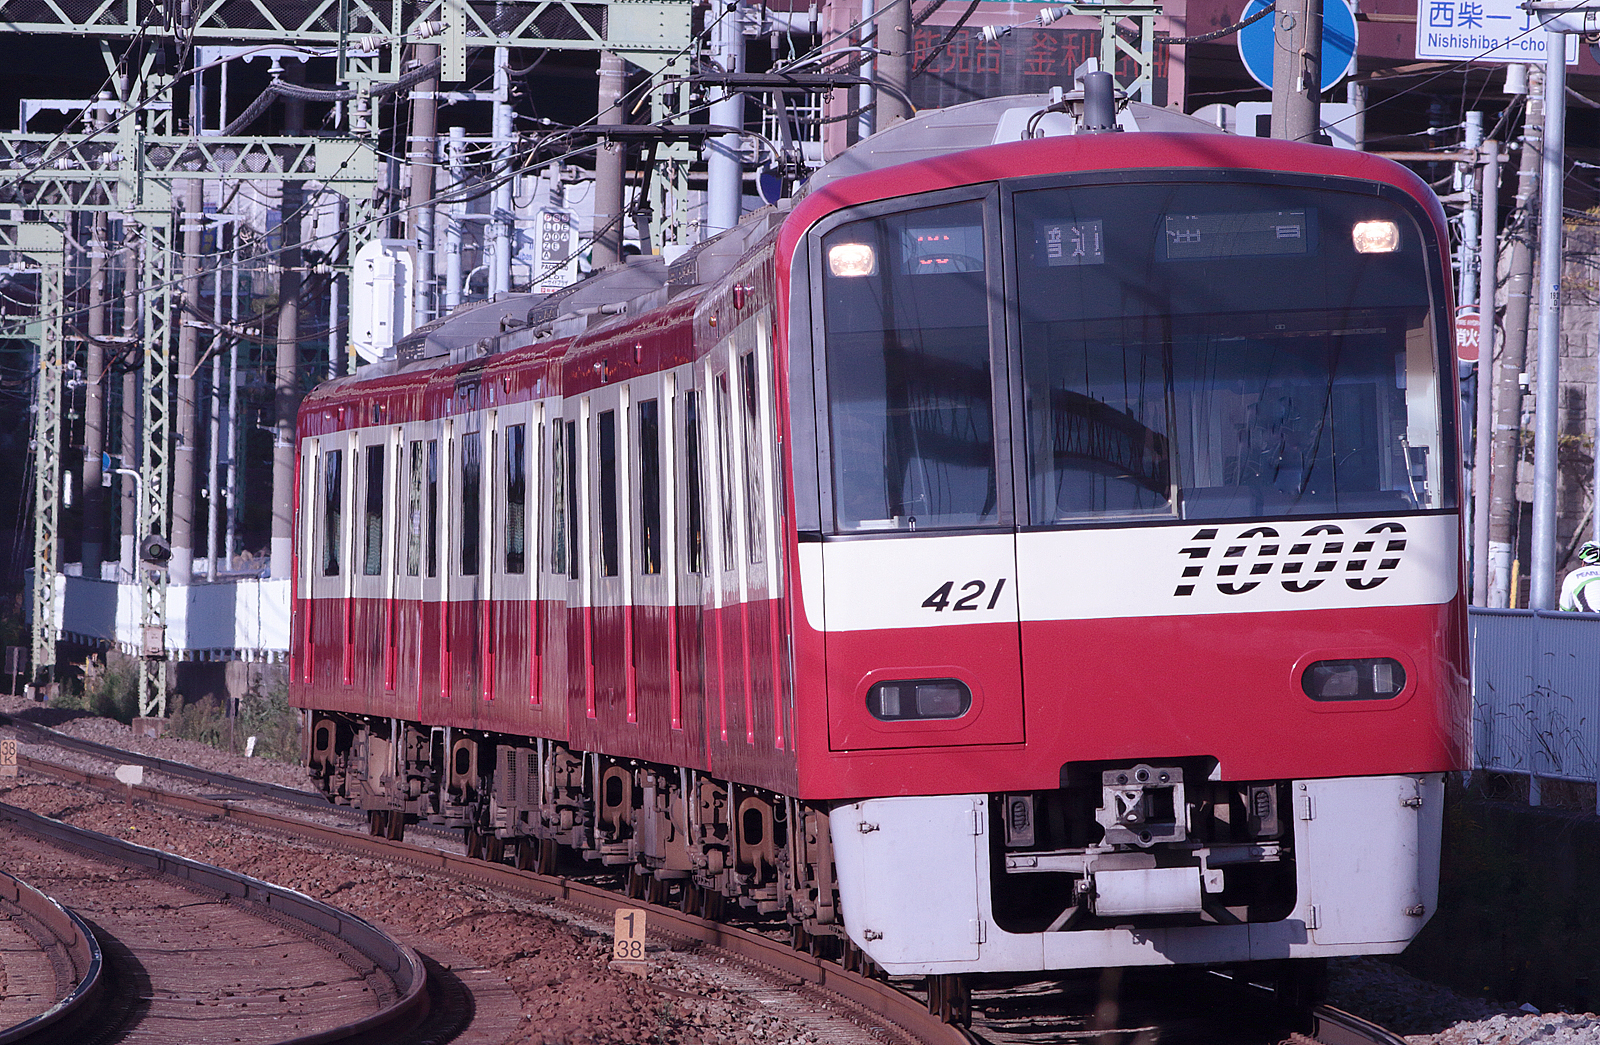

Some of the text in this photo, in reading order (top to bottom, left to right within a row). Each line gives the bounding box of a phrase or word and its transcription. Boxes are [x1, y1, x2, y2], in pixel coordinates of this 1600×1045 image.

[1429, 1, 1534, 31] 西柴一丁
[1428, 33, 1549, 52] Nishishiba 1-cho
[1456, 328, 1480, 347] 消火
[1173, 522, 1407, 596] 1000
[921, 578, 1007, 612] 421
[2, 741, 16, 756] 38
[4, 755, 13, 765] K
[622, 912, 635, 939] 1
[616, 940, 642, 959] 38
